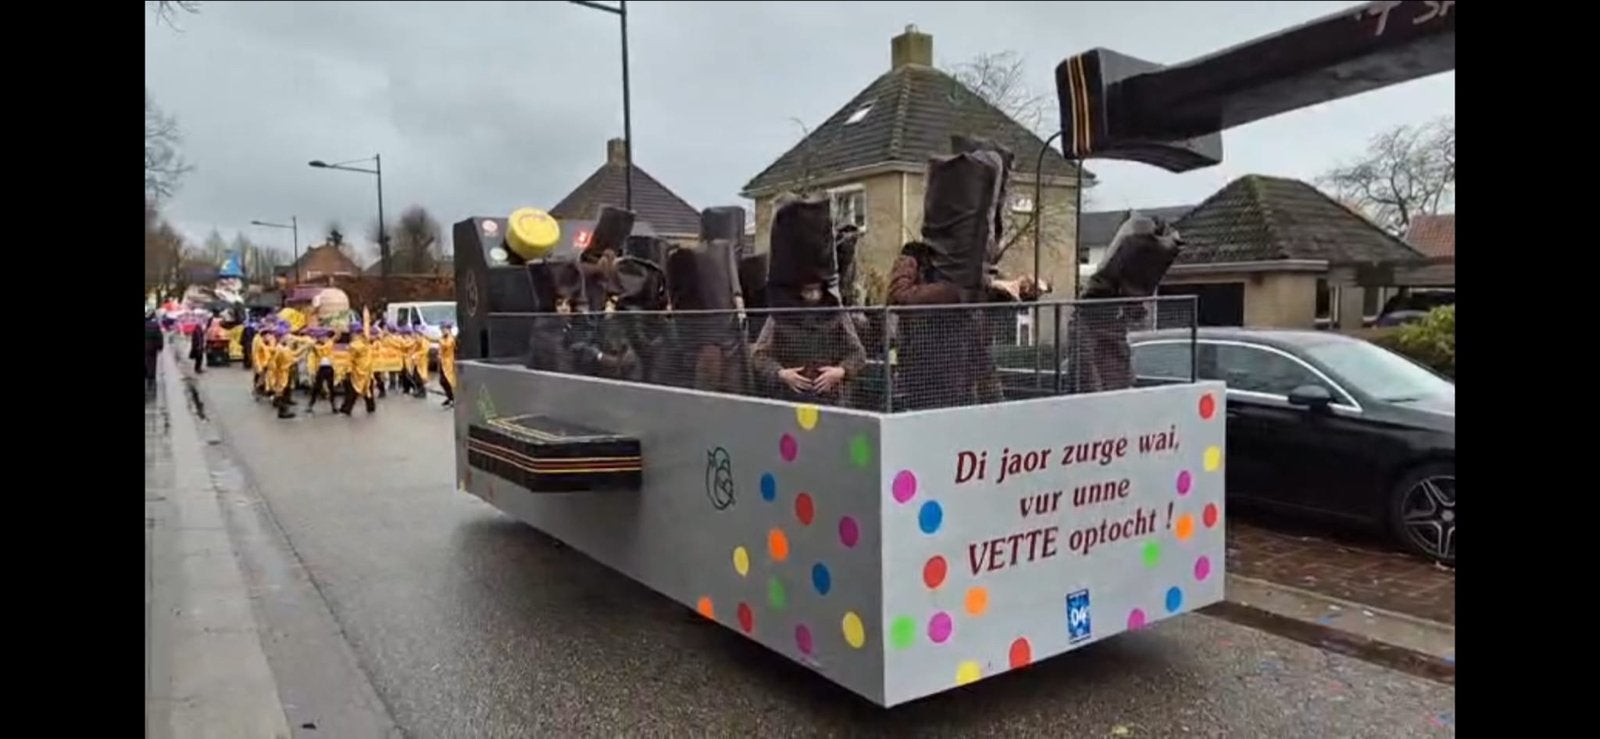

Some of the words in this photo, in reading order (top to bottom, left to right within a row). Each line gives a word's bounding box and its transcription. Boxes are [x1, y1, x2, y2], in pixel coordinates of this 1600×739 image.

[955, 450, 988, 484] Di
[996, 448, 1052, 484] jaor
[1061, 437, 1128, 466] zurge
[1138, 425, 1180, 454] wai,
[1020, 491, 1062, 518] vur
[1073, 478, 1130, 507] unne
[968, 527, 1059, 576] VETTE
[1069, 507, 1156, 555] optocht
